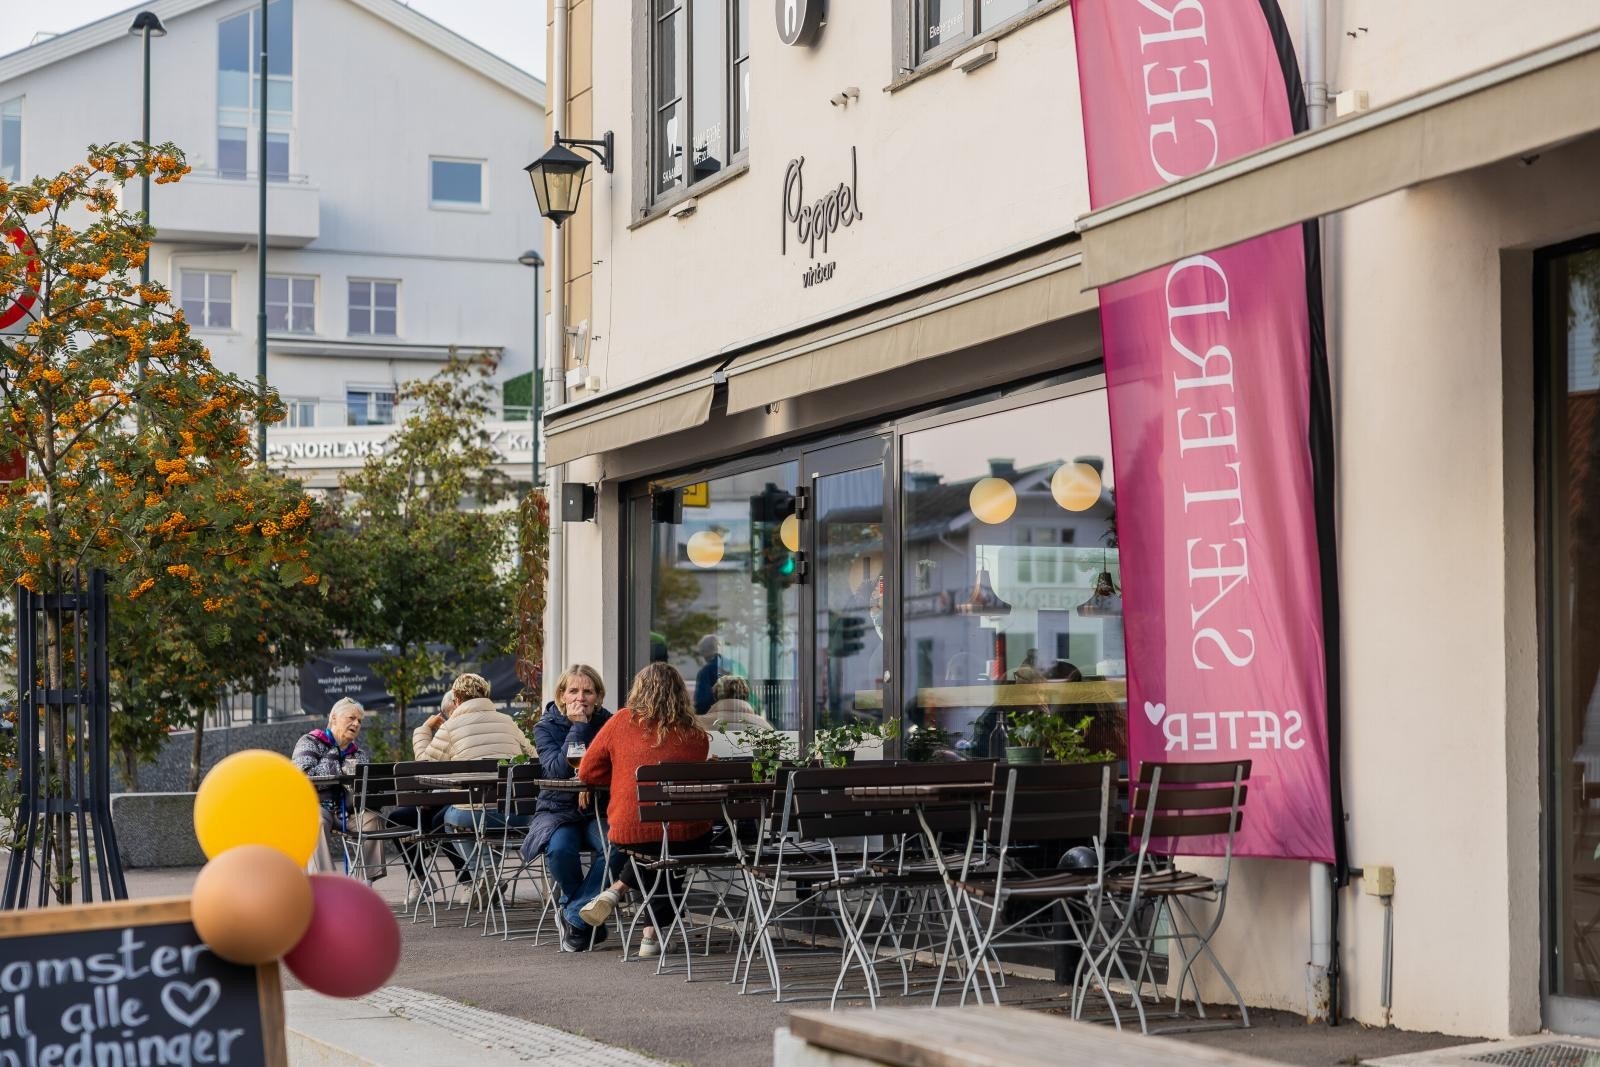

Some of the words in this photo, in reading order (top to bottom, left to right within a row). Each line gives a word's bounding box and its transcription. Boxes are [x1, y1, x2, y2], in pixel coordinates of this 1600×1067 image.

[781, 146, 863, 258] Poppel
[803, 261, 836, 288] vinbar
[291, 440, 384, 458] NORLAKS
[333, 665, 351, 674] Gode
[325, 685, 343, 694] siden
[345, 684, 361, 693] 1994
[0, 928, 209, 993] omster
[61, 984, 150, 1034] alle
